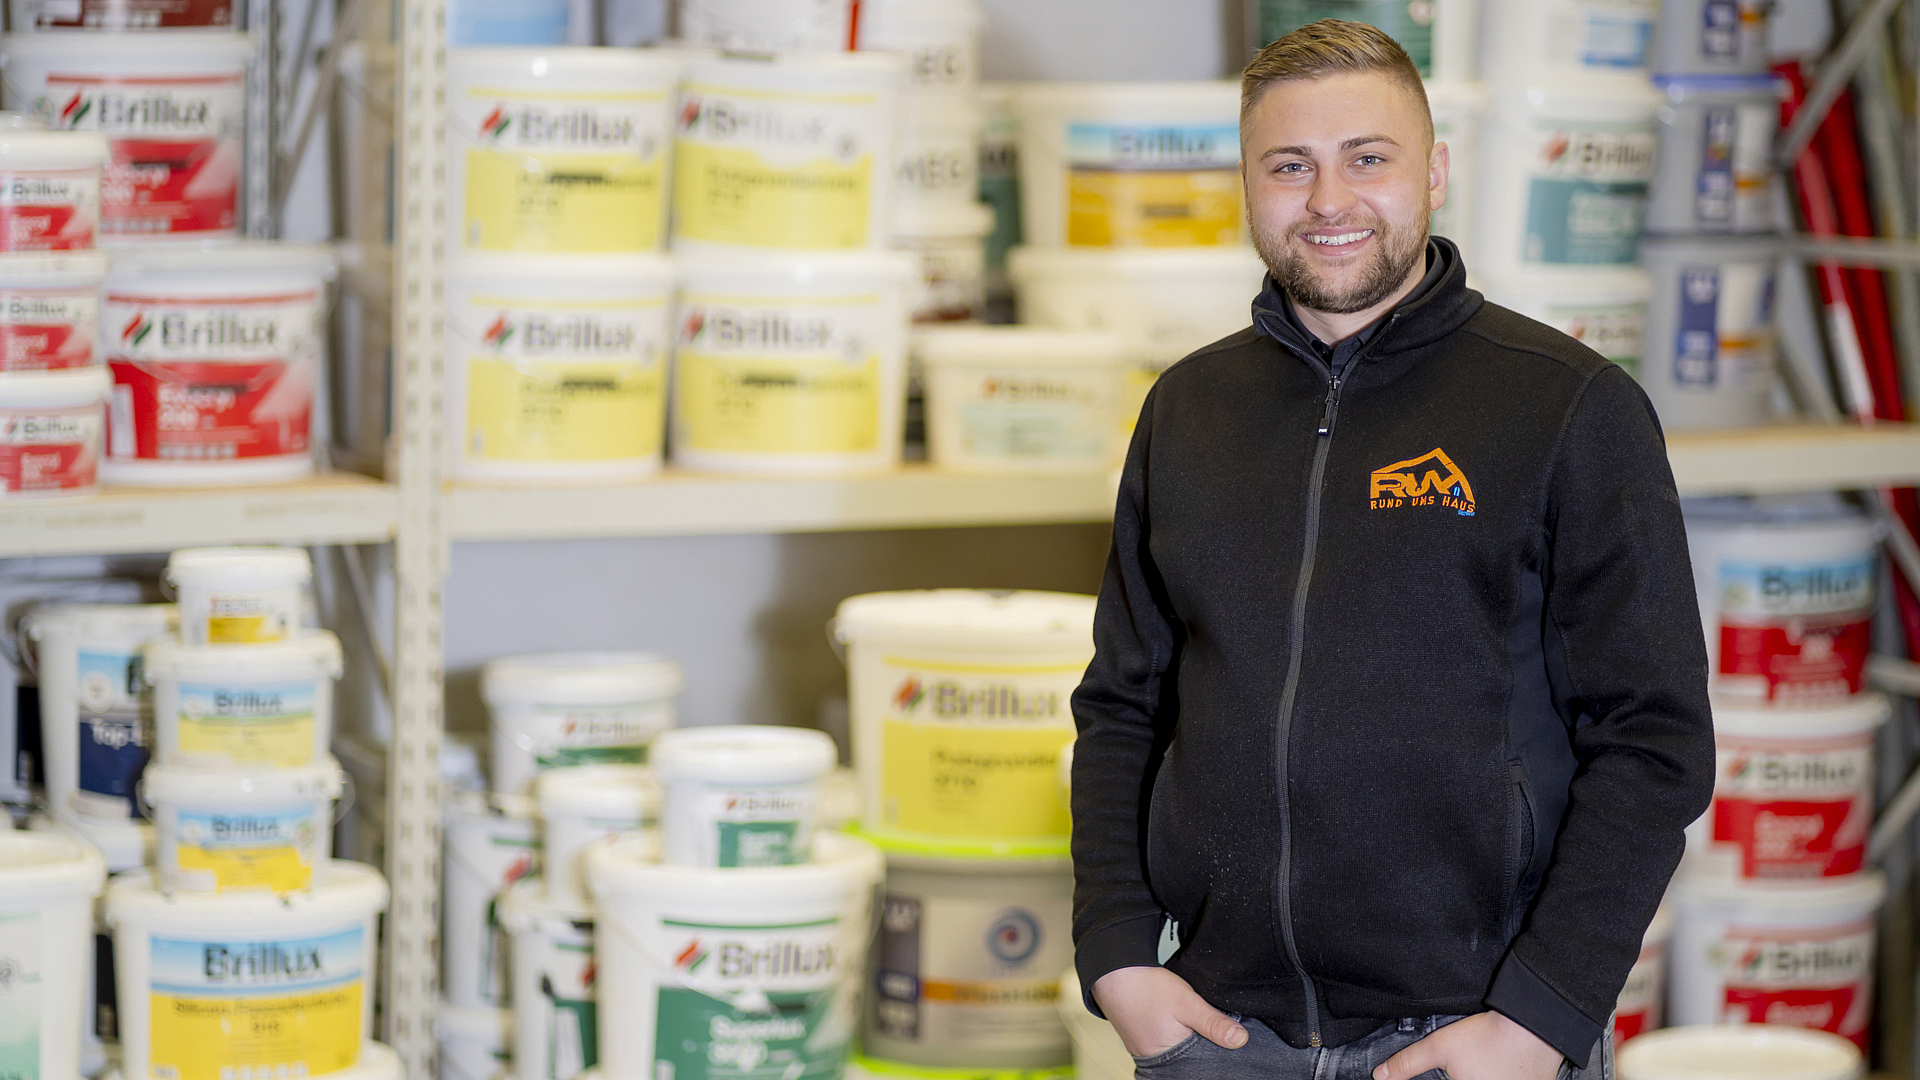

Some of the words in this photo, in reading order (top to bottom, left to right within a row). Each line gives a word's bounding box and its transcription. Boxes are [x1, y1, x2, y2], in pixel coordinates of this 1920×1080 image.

[100, 92, 208, 126] Brillux
[518, 105, 636, 143] Brillux
[1113, 129, 1216, 158] Brillux
[13, 182, 69, 196] Brillux
[10, 301, 67, 314] Brillux
[162, 312, 281, 346] Brillux
[523, 315, 638, 350] Brillux
[713, 312, 830, 349] Brillux
[1370, 499, 1402, 510] RUND
[1442, 496, 1475, 513] HAUS
[1760, 569, 1862, 598] Brillux
[213, 689, 283, 714] Brillux
[938, 684, 1057, 718] Brillux
[1762, 762, 1858, 787] Brillux
[212, 817, 281, 842] Brillux
[203, 941, 326, 983] Brillux
[717, 940, 840, 979] Brillux
[1775, 947, 1862, 973] Brillux
